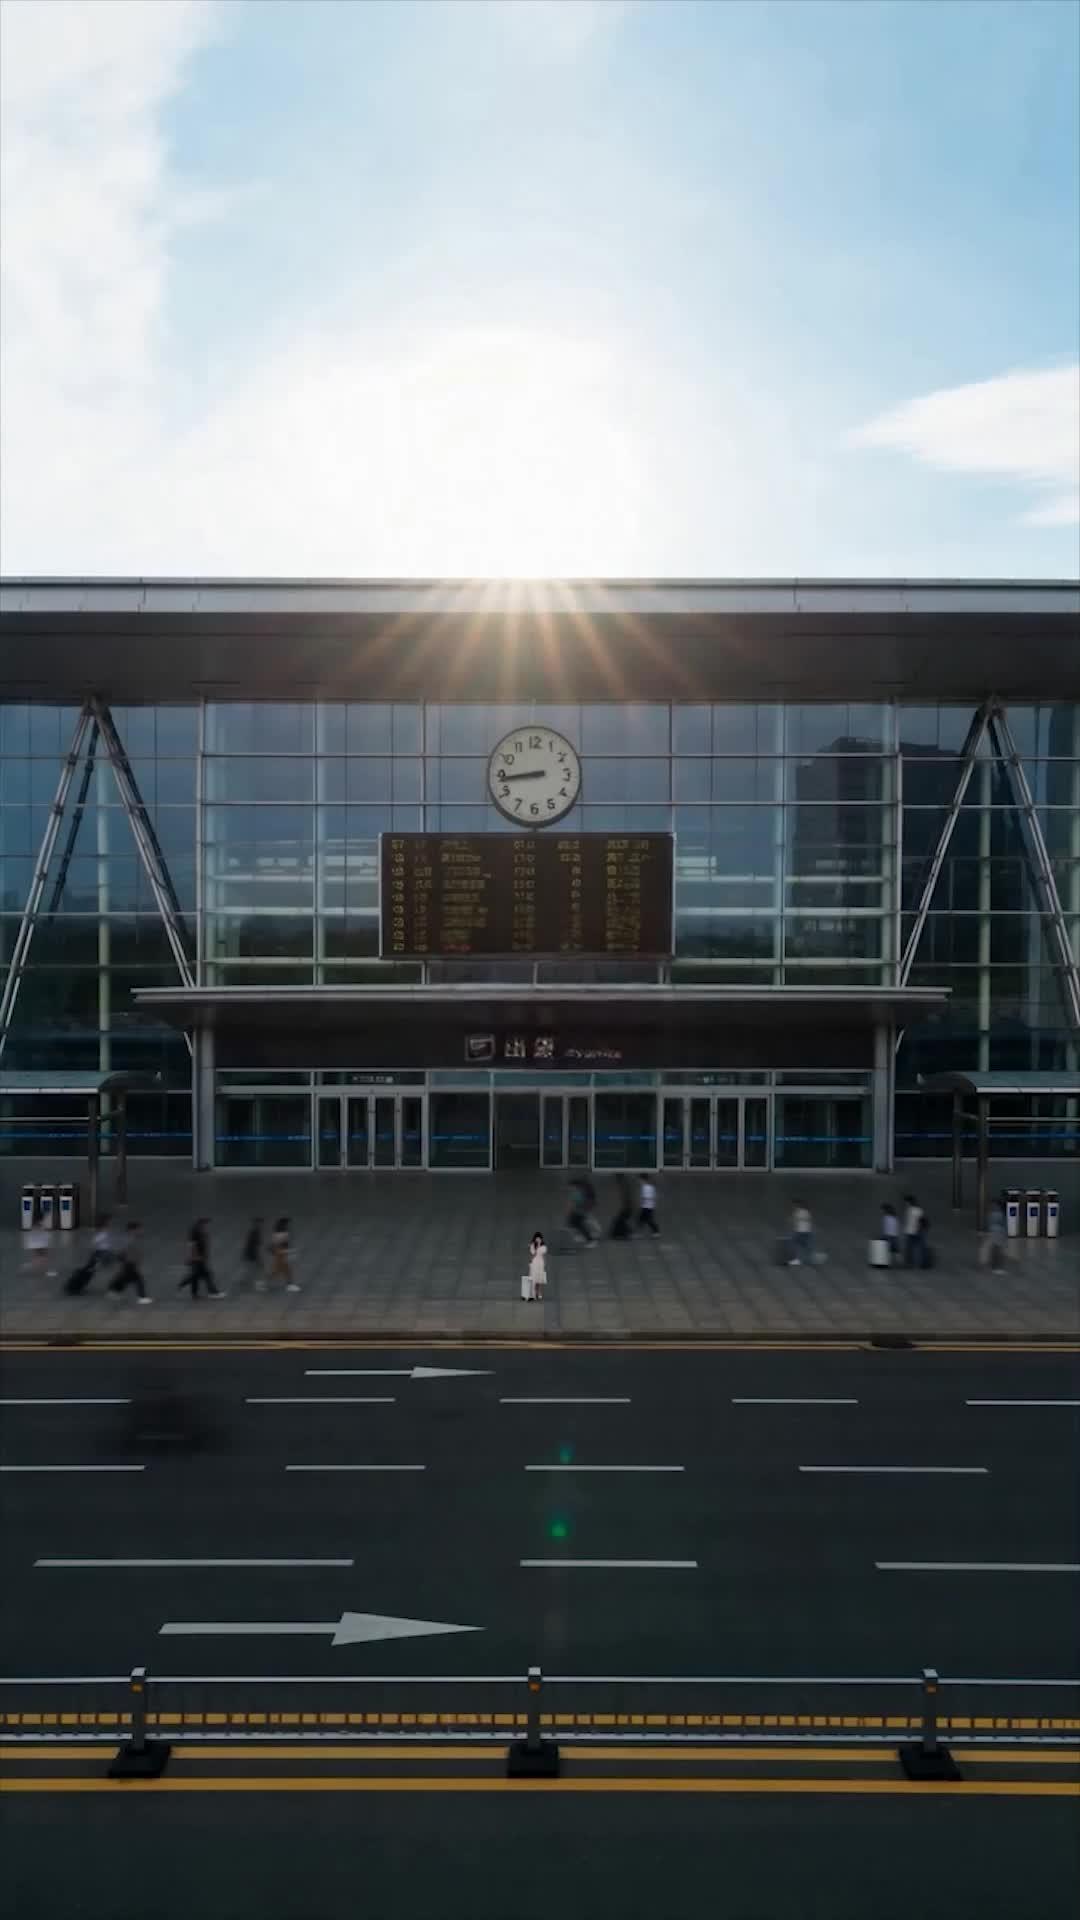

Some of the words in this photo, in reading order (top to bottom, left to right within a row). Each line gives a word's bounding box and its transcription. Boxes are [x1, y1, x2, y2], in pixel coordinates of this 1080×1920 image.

[529, 736, 542, 749] 12
[514, 798, 523, 812] 7
[530, 803, 539, 815] 6
[547, 798, 555, 810] 5
